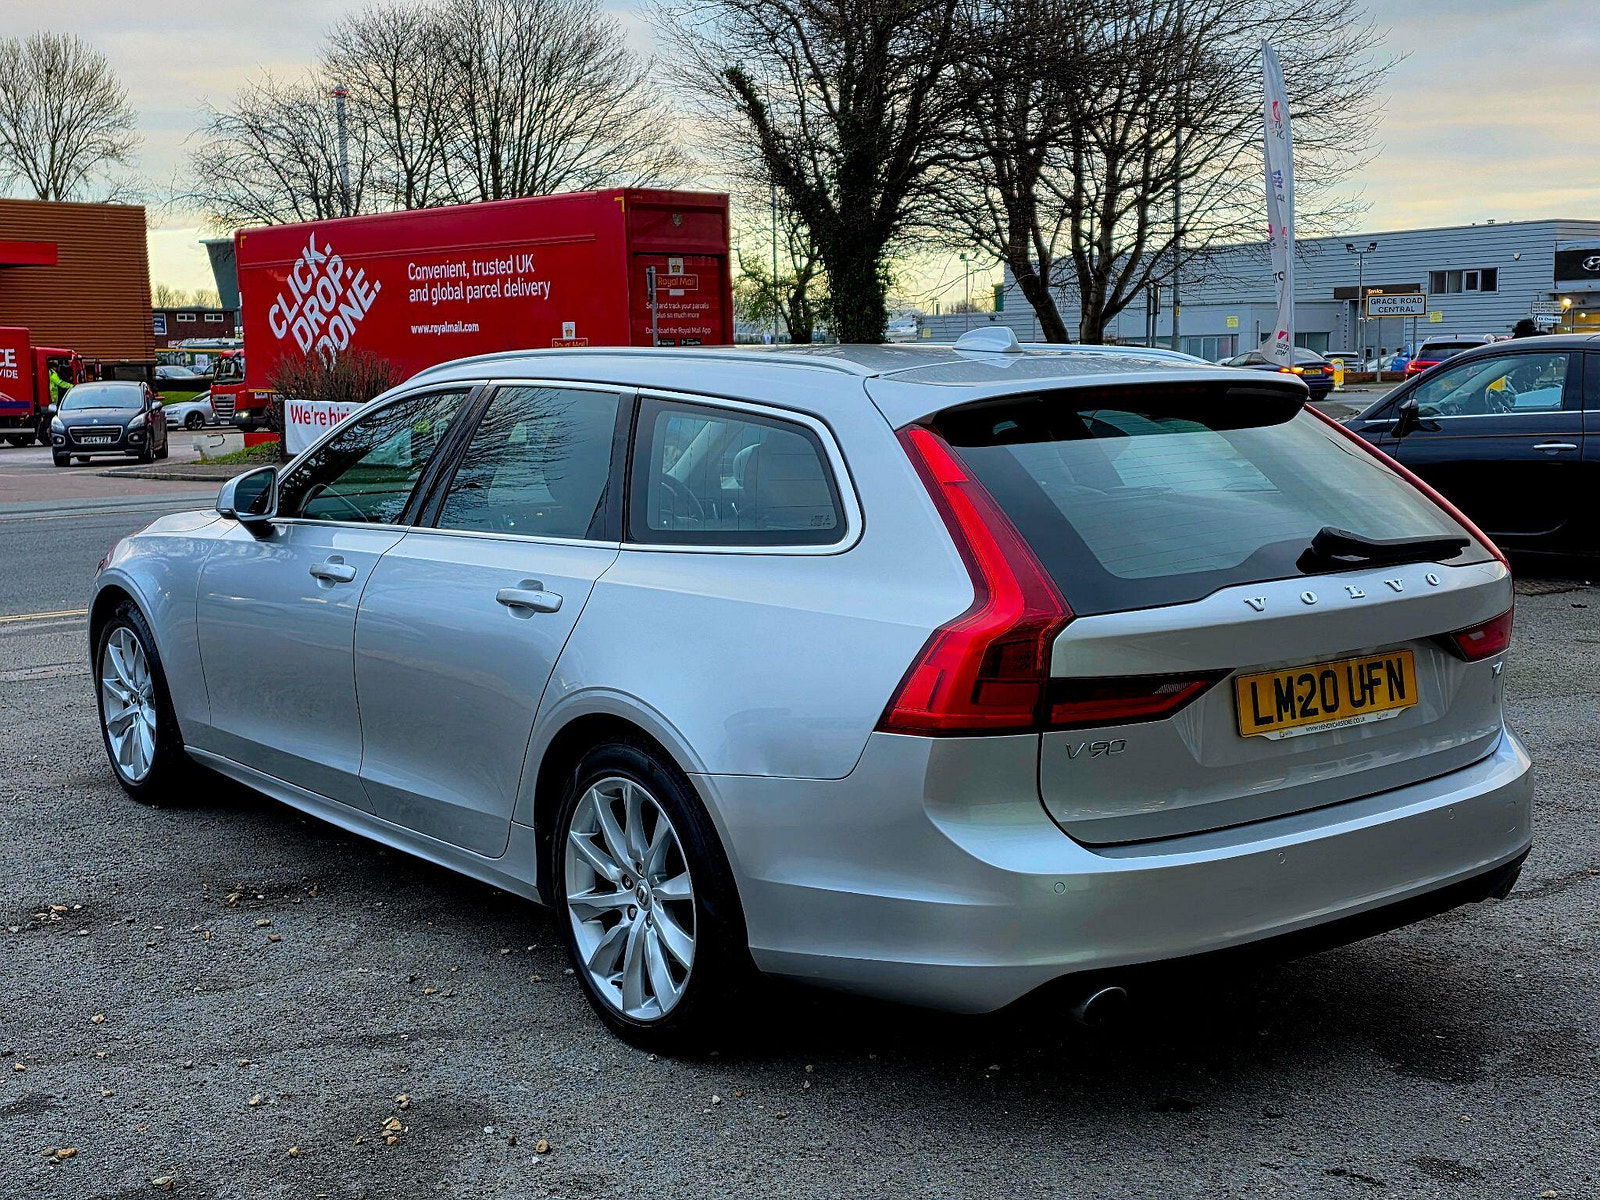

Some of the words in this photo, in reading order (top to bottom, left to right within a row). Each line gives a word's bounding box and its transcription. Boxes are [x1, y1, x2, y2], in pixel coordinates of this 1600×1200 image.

[407, 260, 470, 281] Convenient,
[472, 254, 514, 276] trusted
[516, 253, 535, 273] UK
[268, 231, 332, 339] CLICK.
[409, 282, 429, 302] and
[431, 280, 464, 306] global
[466, 278, 501, 304] parcel
[504, 277, 551, 300] delivery
[657, 277, 679, 287] Royal
[680, 277, 696, 286] Mail
[291, 254, 354, 356] DROP.
[1370, 297, 1398, 305] GRACE
[315, 267, 382, 370] DONE.
[410, 321, 480, 335] www.royalmail.com
[677, 326, 691, 335] Royal
[702, 327, 712, 335] App
[290, 404, 327, 426] We're
[1244, 572, 1441, 612] VOLVO
[1250, 669, 1340, 727] LM20
[1346, 657, 1406, 709] UFN
[1064, 738, 1127, 760] V90
